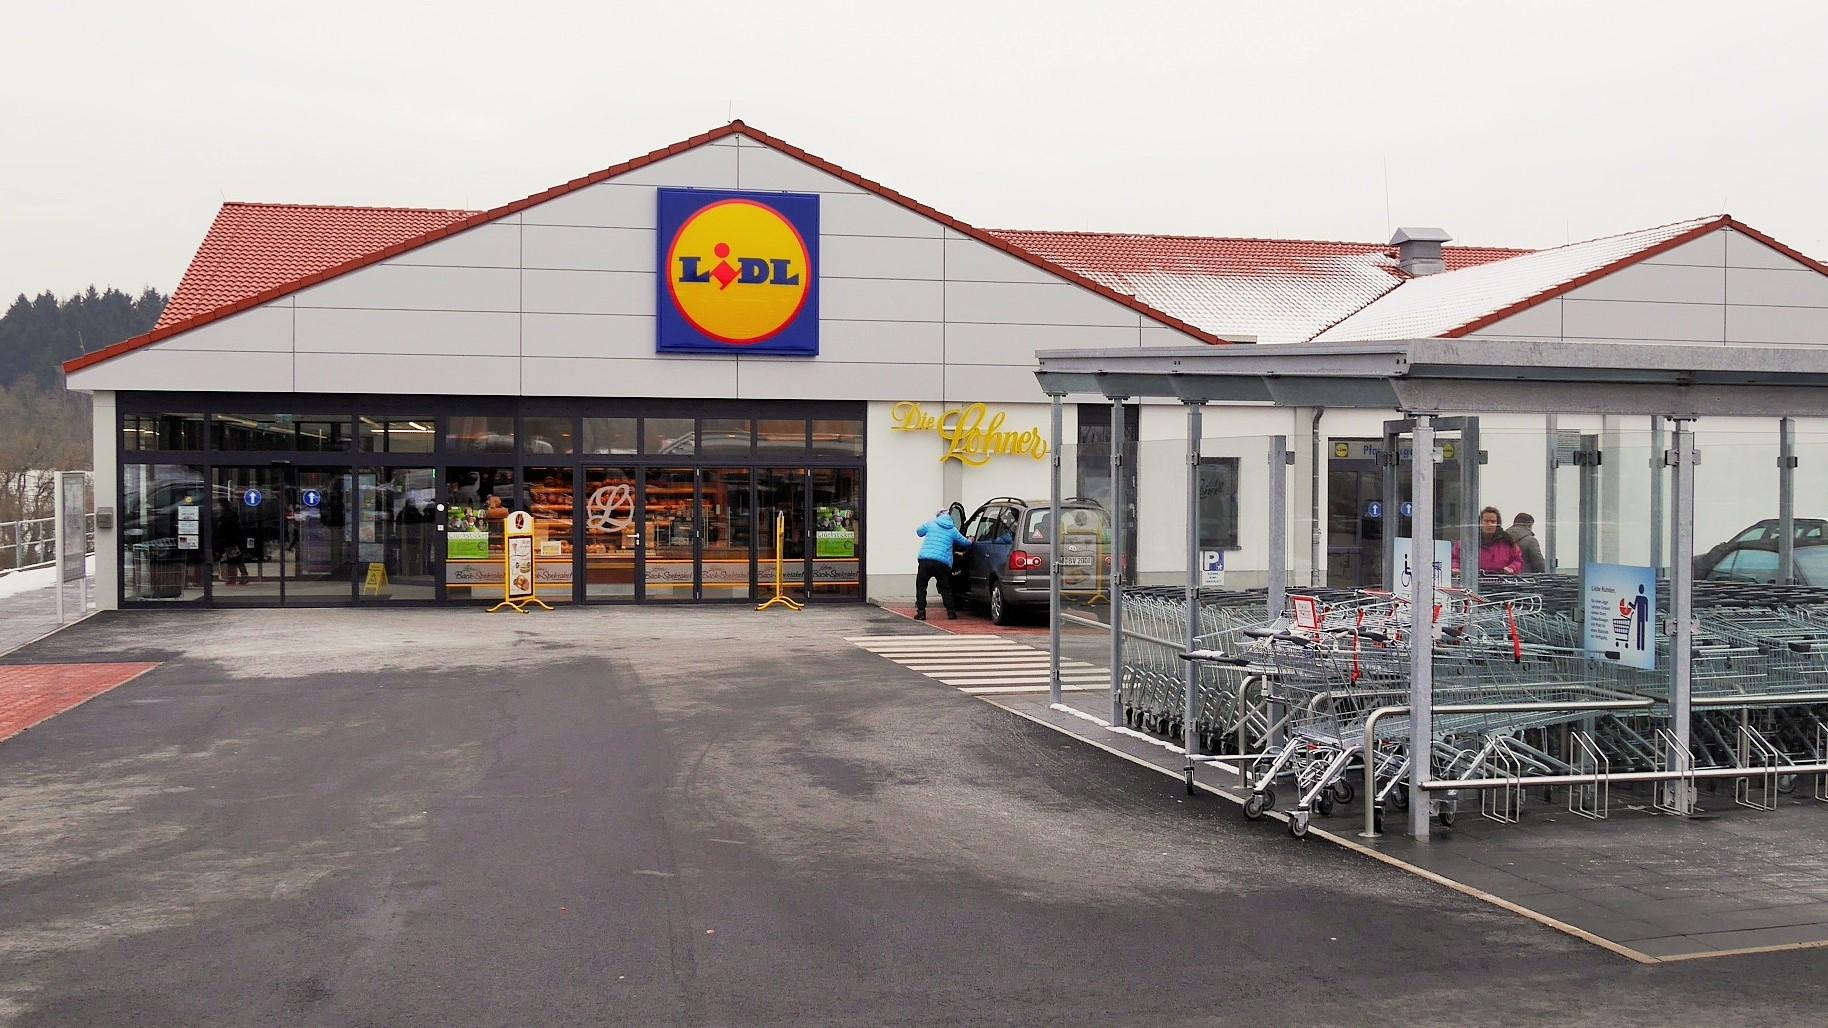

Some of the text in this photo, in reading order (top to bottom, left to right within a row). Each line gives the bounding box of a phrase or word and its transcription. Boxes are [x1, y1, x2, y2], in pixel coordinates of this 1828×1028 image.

[890, 401, 1047, 468] Die Lohner
[1203, 551, 1220, 571] P
